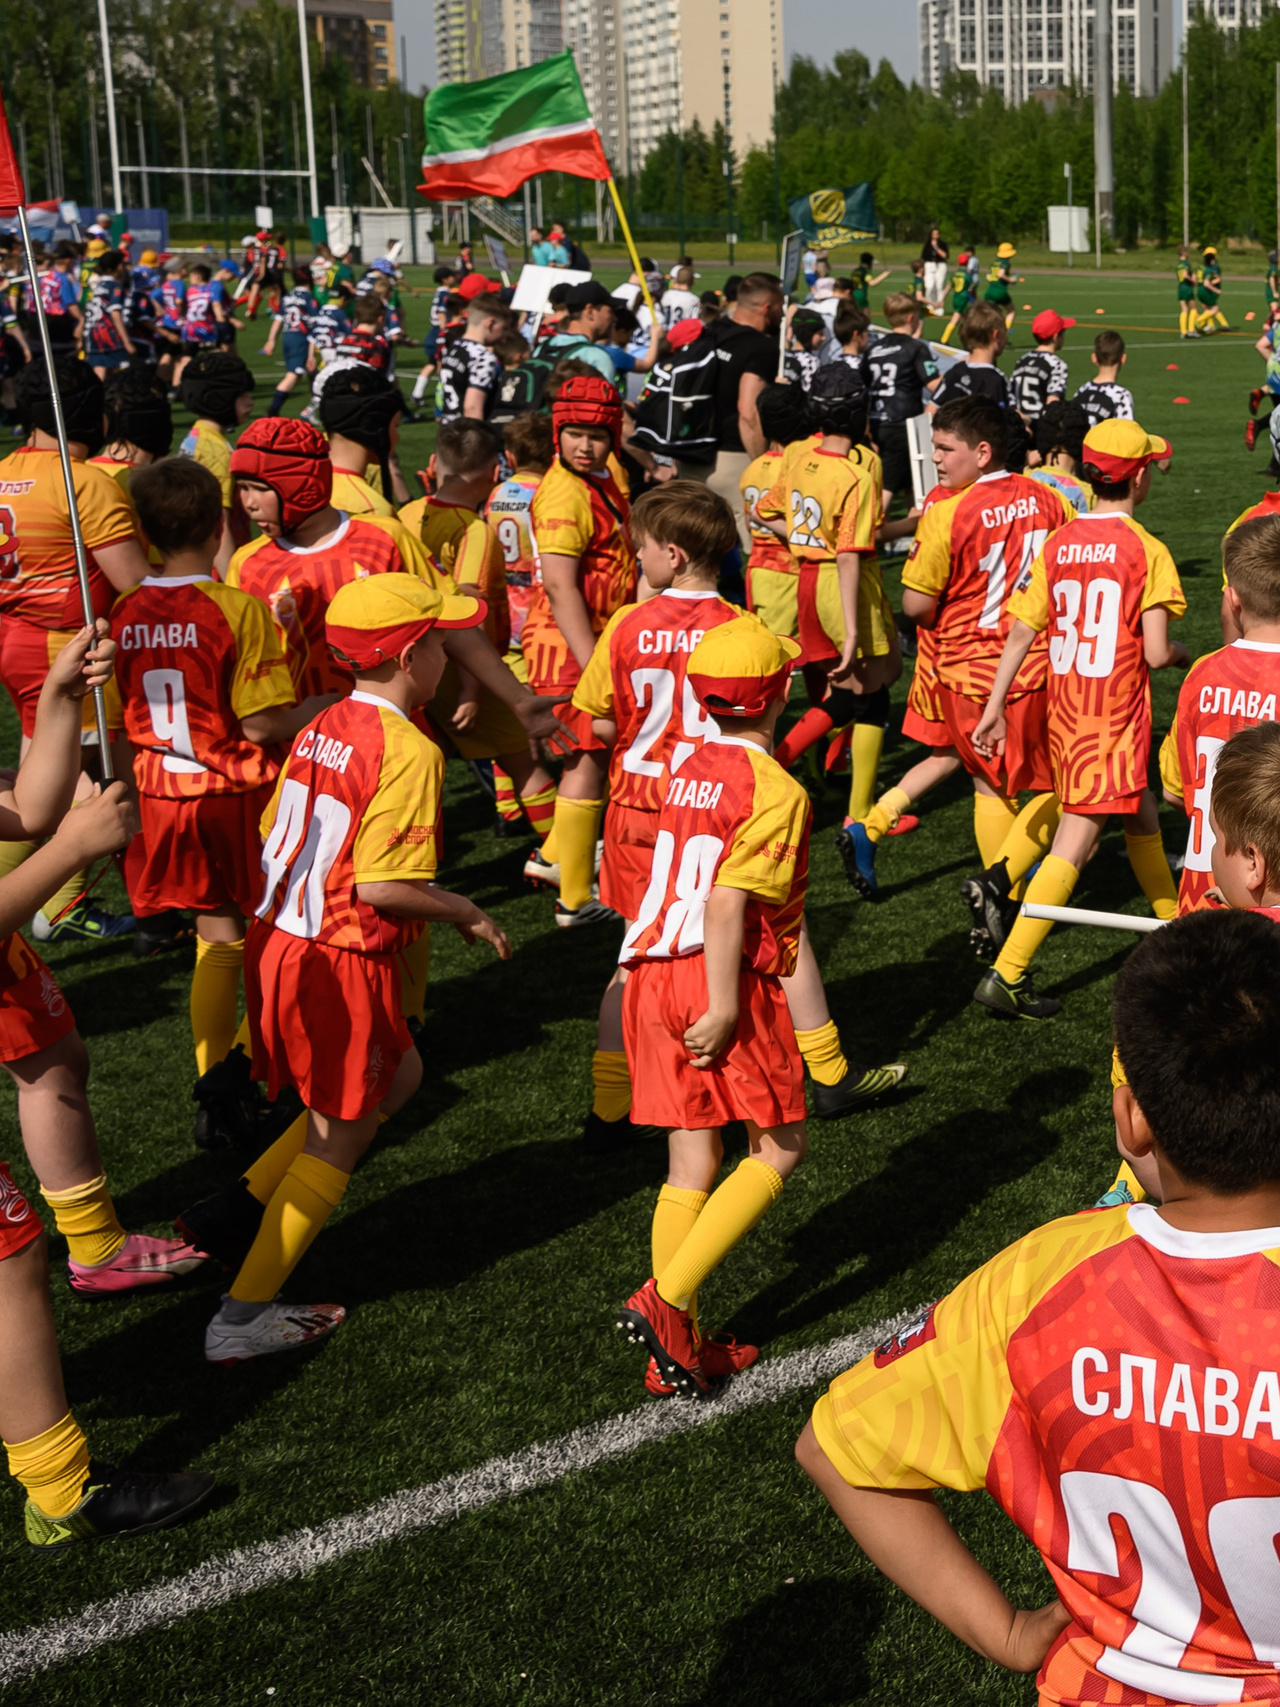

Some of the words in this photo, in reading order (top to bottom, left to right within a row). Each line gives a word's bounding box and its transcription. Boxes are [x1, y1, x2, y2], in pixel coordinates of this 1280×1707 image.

[980, 494, 1041, 529] СЛАВА
[497, 518, 520, 563] 9
[1055, 542, 1118, 565] СЛАВА
[121, 622, 199, 651] СЛАВА
[637, 629, 707, 655] СЛАВ
[1049, 577, 1122, 678] 39
[141, 667, 209, 774] 9
[1199, 685, 1278, 722] СЛАВА
[295, 729, 355, 775] СЛАВА
[665, 777, 725, 811] ЛАВА
[617, 828, 725, 966] 18
